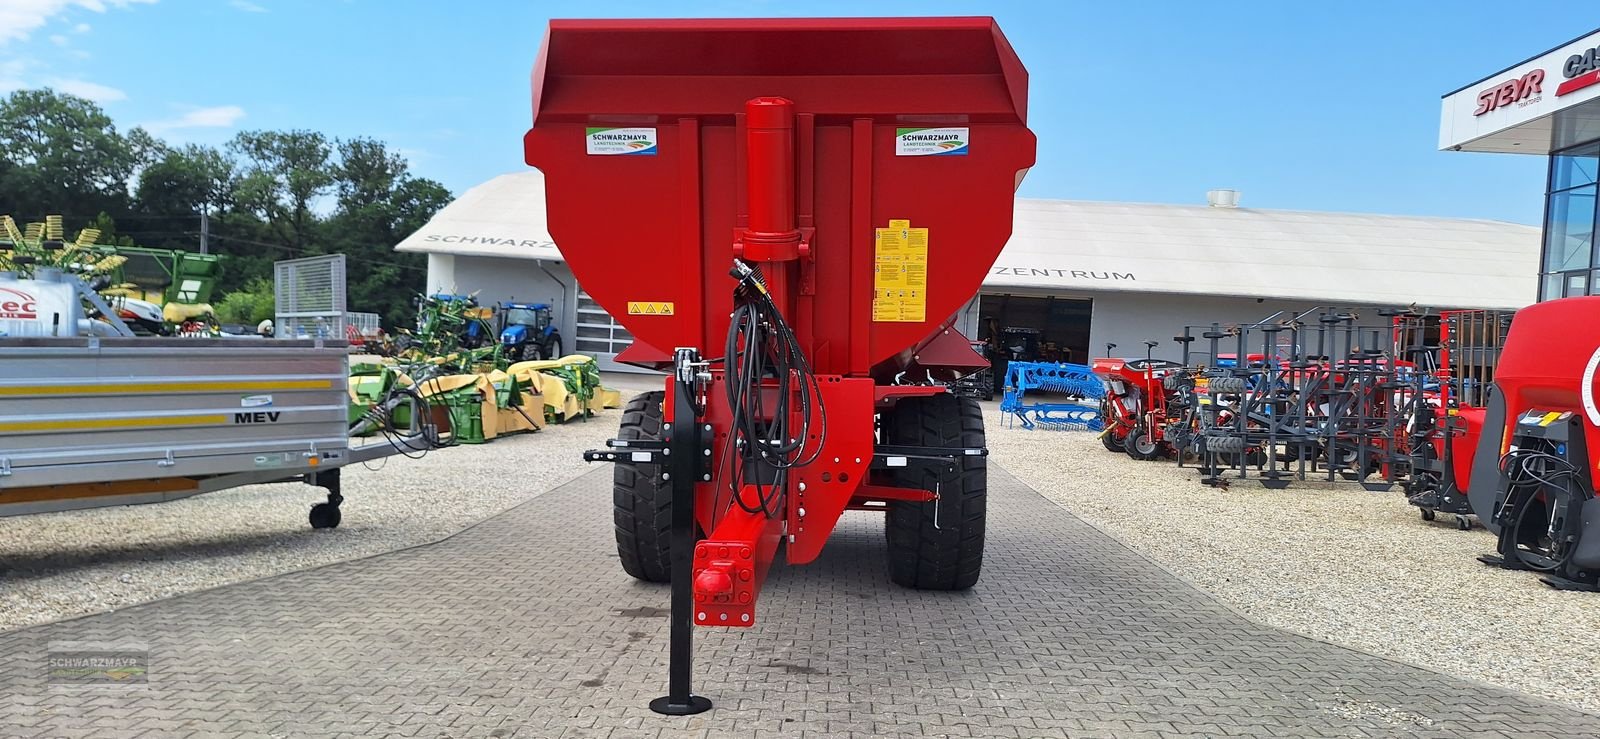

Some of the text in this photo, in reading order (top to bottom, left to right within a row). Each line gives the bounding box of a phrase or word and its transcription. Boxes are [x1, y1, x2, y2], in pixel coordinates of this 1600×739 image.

[1473, 68, 1545, 116] STEYR
[993, 266, 1136, 280] ZENTRUM
[235, 411, 281, 424] MEV
